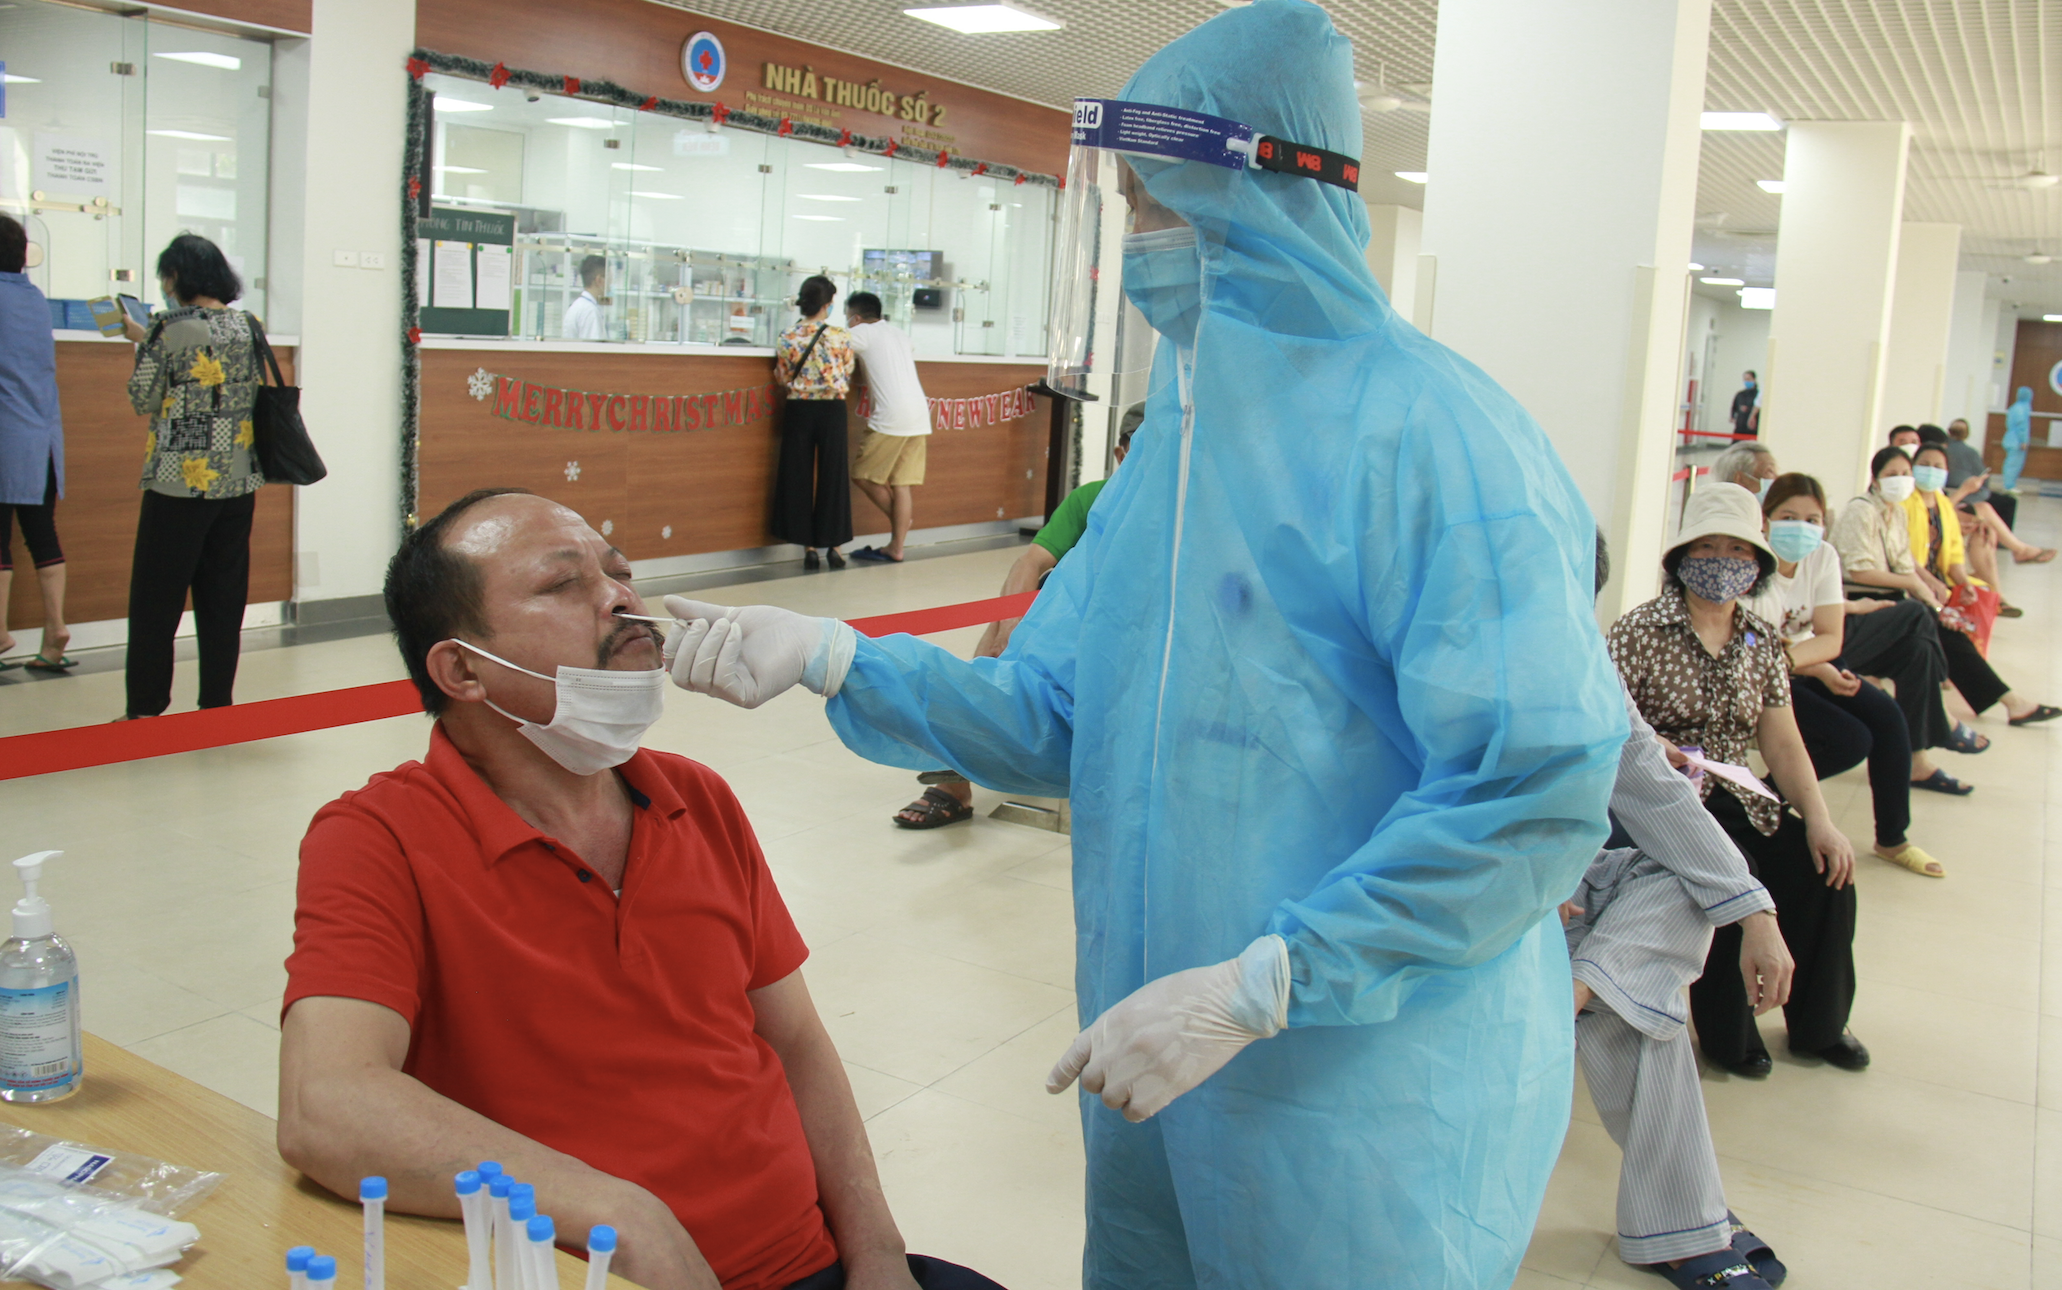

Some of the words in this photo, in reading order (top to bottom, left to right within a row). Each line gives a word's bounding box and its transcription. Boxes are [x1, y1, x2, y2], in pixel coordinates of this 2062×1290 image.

[764, 62, 818, 99] NHÀ
[822, 79, 895, 116] THUỐC
[900, 90, 930, 122] SỐ
[933, 104, 947, 127] 2
